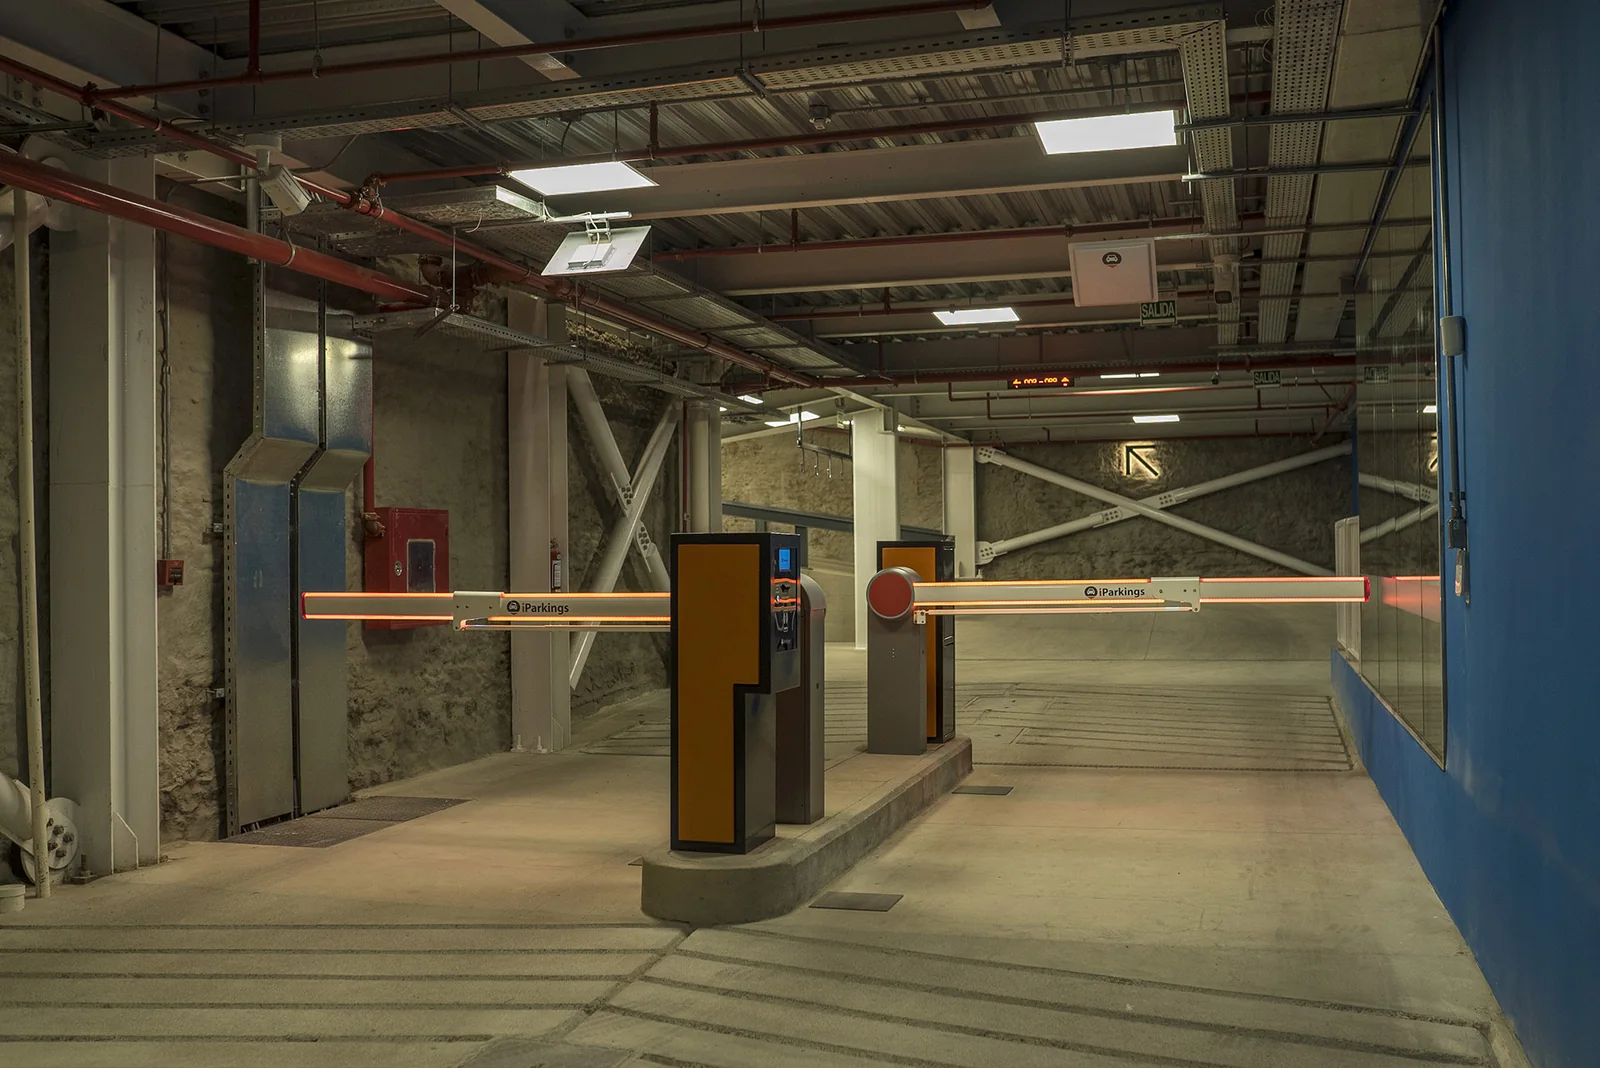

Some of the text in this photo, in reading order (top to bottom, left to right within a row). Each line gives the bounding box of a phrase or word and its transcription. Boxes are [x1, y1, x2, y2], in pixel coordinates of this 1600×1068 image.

[1141, 302, 1176, 318] SALIDA
[1254, 371, 1280, 384] SALIDA
[1098, 587, 1145, 598] iParkings
[521, 602, 570, 615] iParkings
